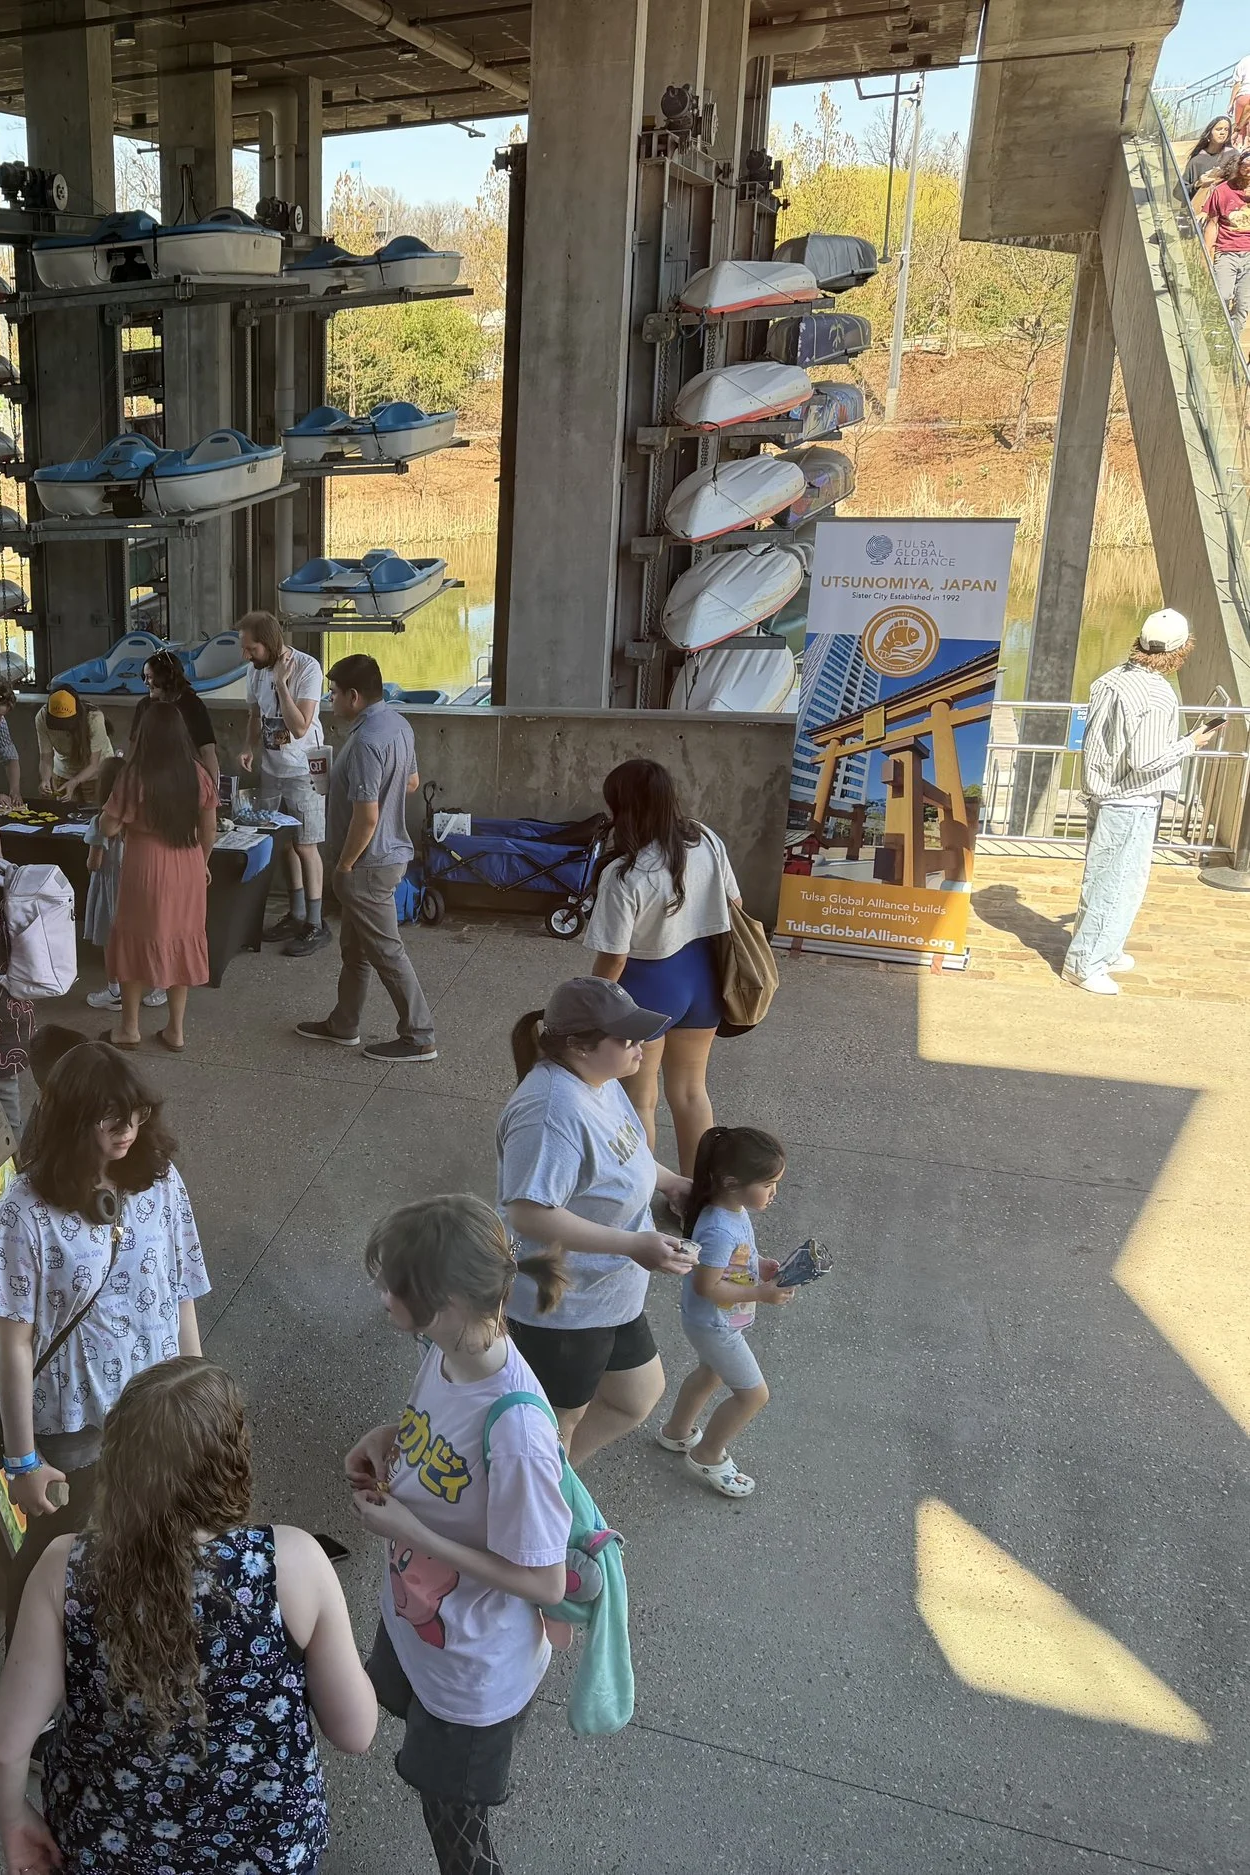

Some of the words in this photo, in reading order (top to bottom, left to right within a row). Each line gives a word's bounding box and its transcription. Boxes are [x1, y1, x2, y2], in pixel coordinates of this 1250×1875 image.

[896, 539, 935, 548] TULSA
[895, 548, 945, 558] GLOBAL
[893, 557, 956, 567] ALLIANCE
[821, 575, 934, 592] UTSUNOMIYA,
[940, 578, 998, 592] JAPAN
[852, 591, 872, 600] Sister
[873, 592, 888, 601] City
[890, 592, 931, 601] Established
[942, 594, 960, 602] 1992
[310, 760, 324, 773] QT
[800, 890, 826, 902] Tulsa
[829, 893, 865, 906] Global
[867, 898, 910, 912] Alliance
[912, 902, 947, 915] builds
[821, 904, 855, 917] global
[857, 909, 921, 925] community.
[785, 919, 956, 952] TulsaGlobalAlliance.org
